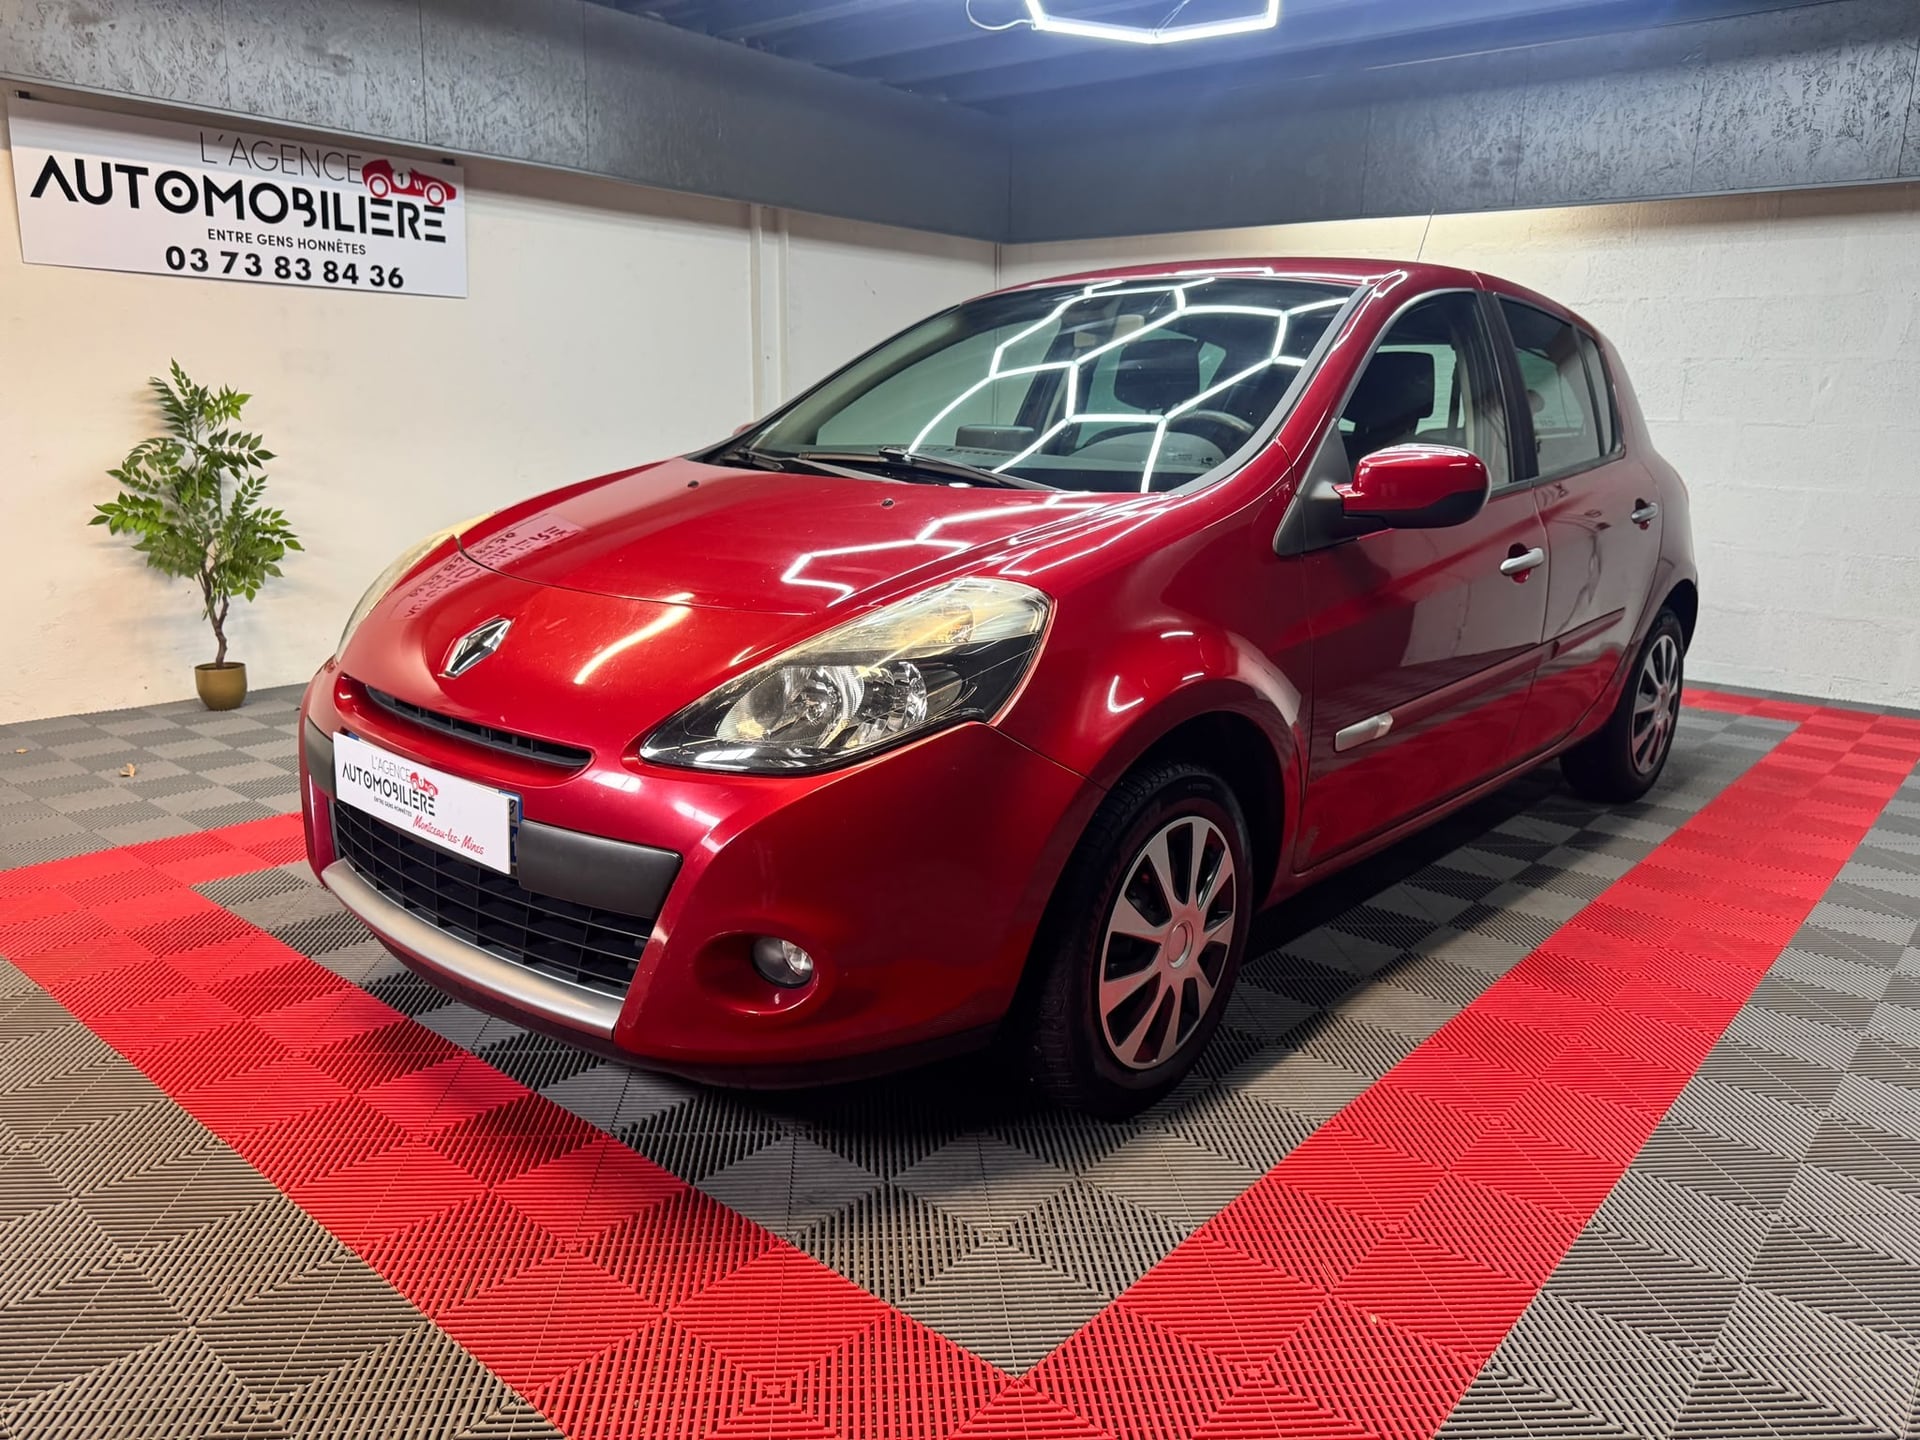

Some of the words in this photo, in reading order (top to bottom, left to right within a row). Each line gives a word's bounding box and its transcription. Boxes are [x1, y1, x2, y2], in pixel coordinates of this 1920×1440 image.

[199, 131, 363, 185] L'AGENCE
[30, 154, 447, 243] AUTOMOBILIERE
[207, 228, 253, 244] ENTRE
[257, 233, 294, 248] GENS
[297, 238, 367, 255] HONNÊTES
[165, 245, 210, 272] 03
[220, 250, 263, 277] 73
[273, 255, 312, 281] 83
[322, 260, 360, 285] 84
[369, 264, 405, 289] 36
[342, 761, 436, 817] AUTOMOBILIERE
[371, 754, 412, 784] L'AGENCE
